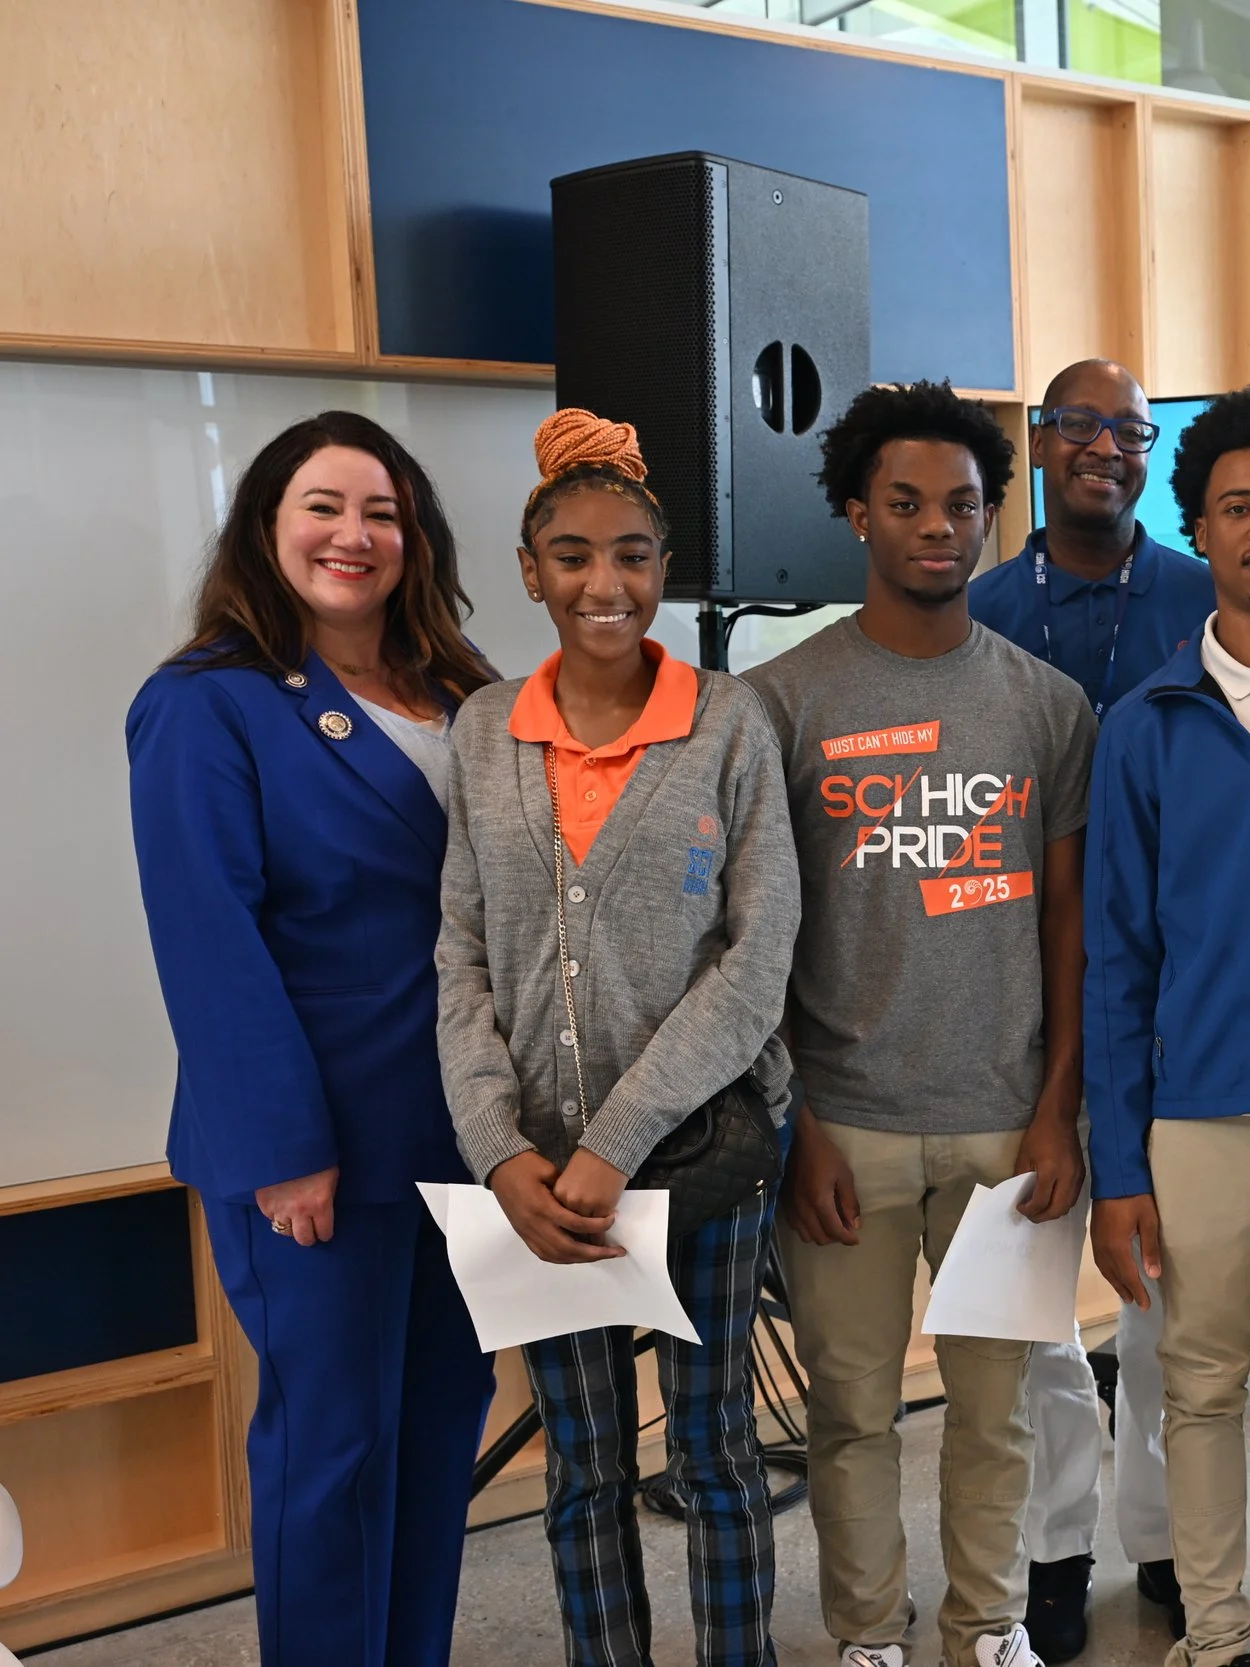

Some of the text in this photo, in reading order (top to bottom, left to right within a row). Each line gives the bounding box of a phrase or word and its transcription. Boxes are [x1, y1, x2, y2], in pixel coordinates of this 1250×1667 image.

[828, 728, 934, 756] JUST CAN'T HIDE MY
[820, 773, 1032, 819] SCI HIGH
[855, 825, 1003, 868] PRIDE
